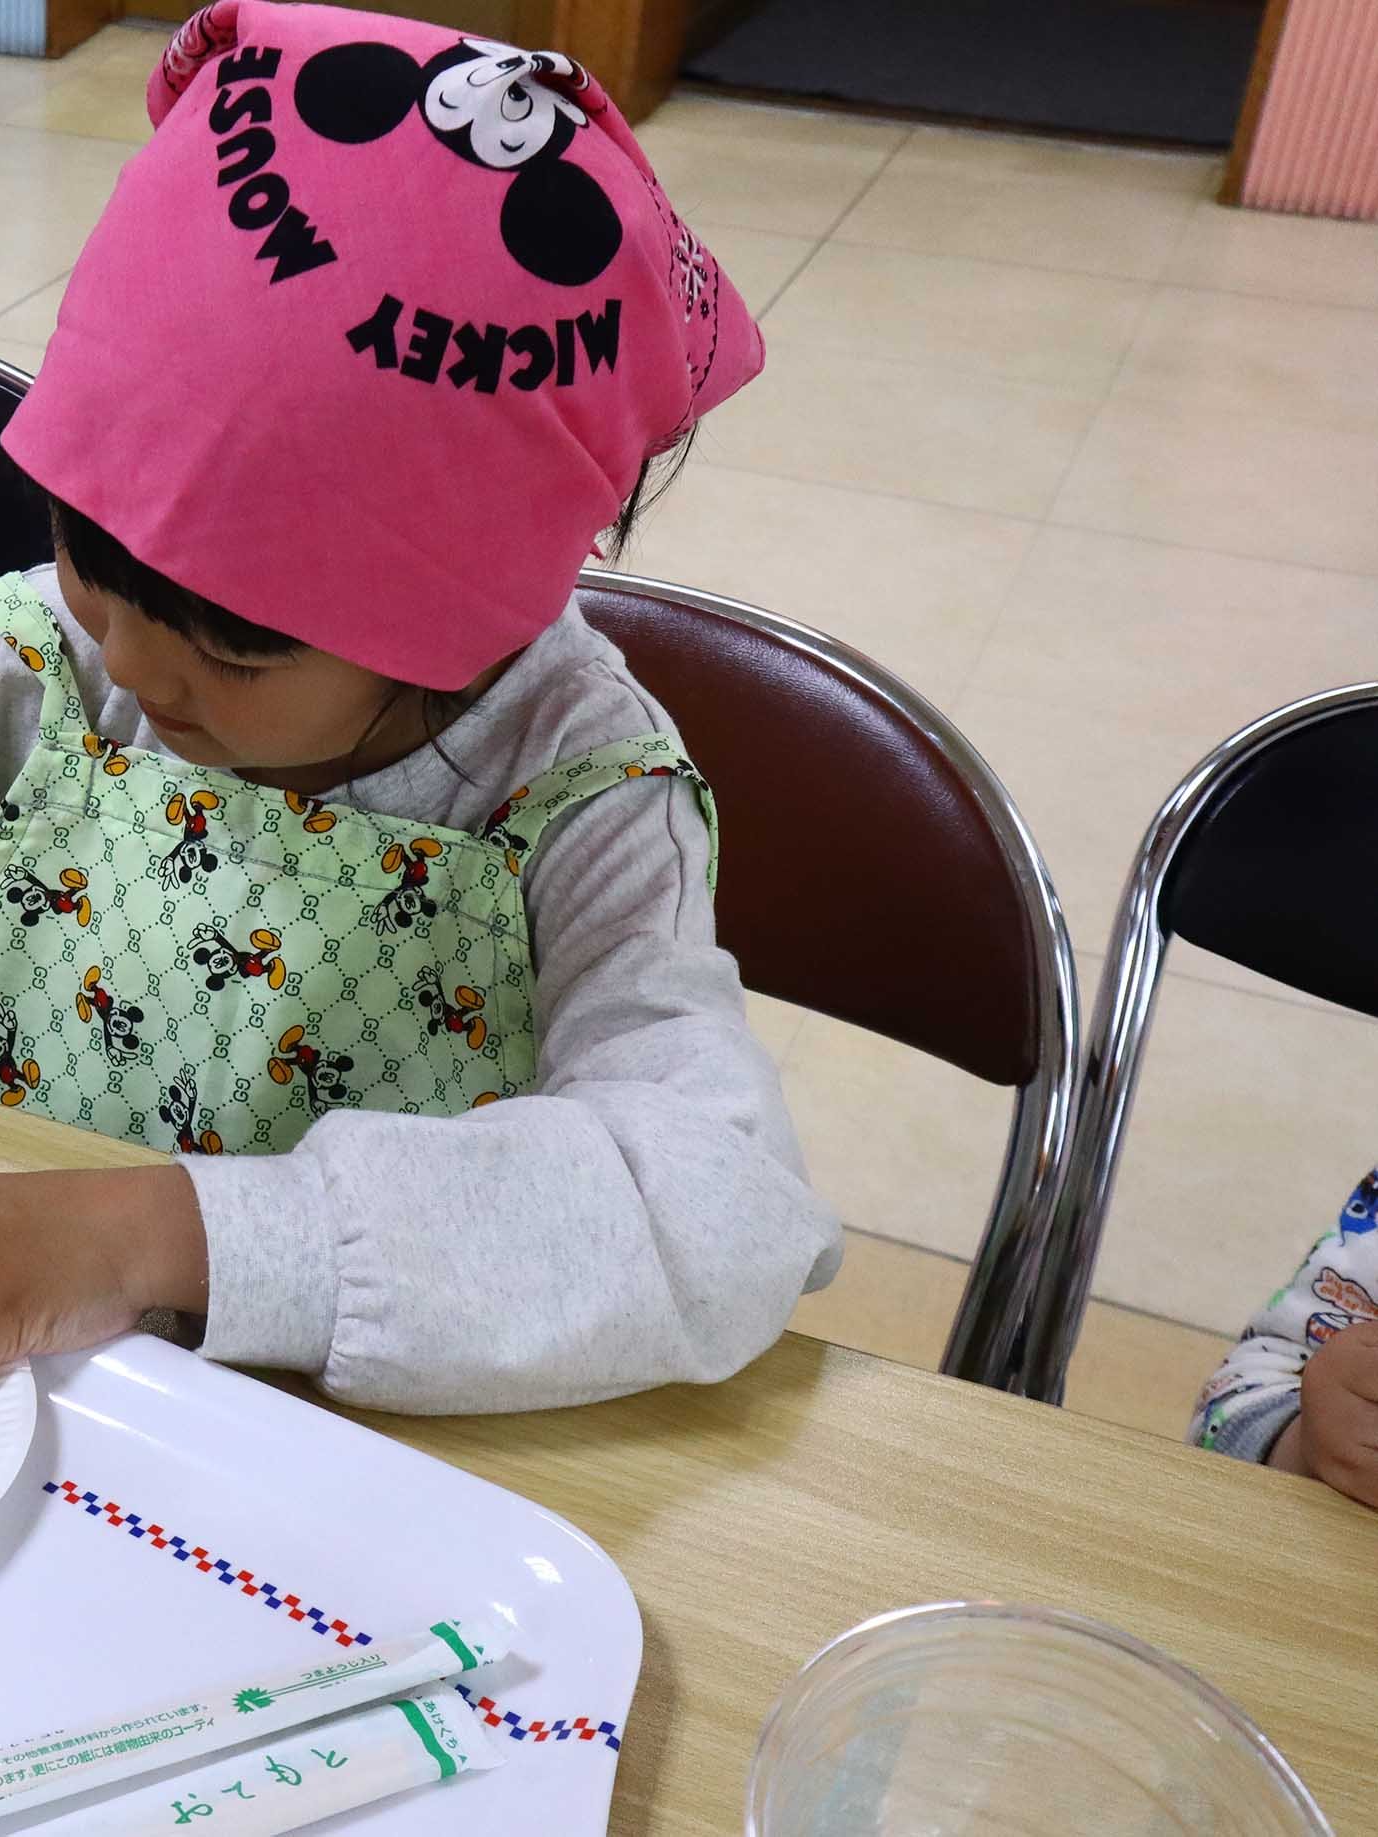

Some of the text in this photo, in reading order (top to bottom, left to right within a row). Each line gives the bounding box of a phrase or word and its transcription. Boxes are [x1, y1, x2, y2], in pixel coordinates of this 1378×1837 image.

[208, 45, 621, 393] MICKEY MOUSE
[170, 1749, 349, 1824] おてもと
